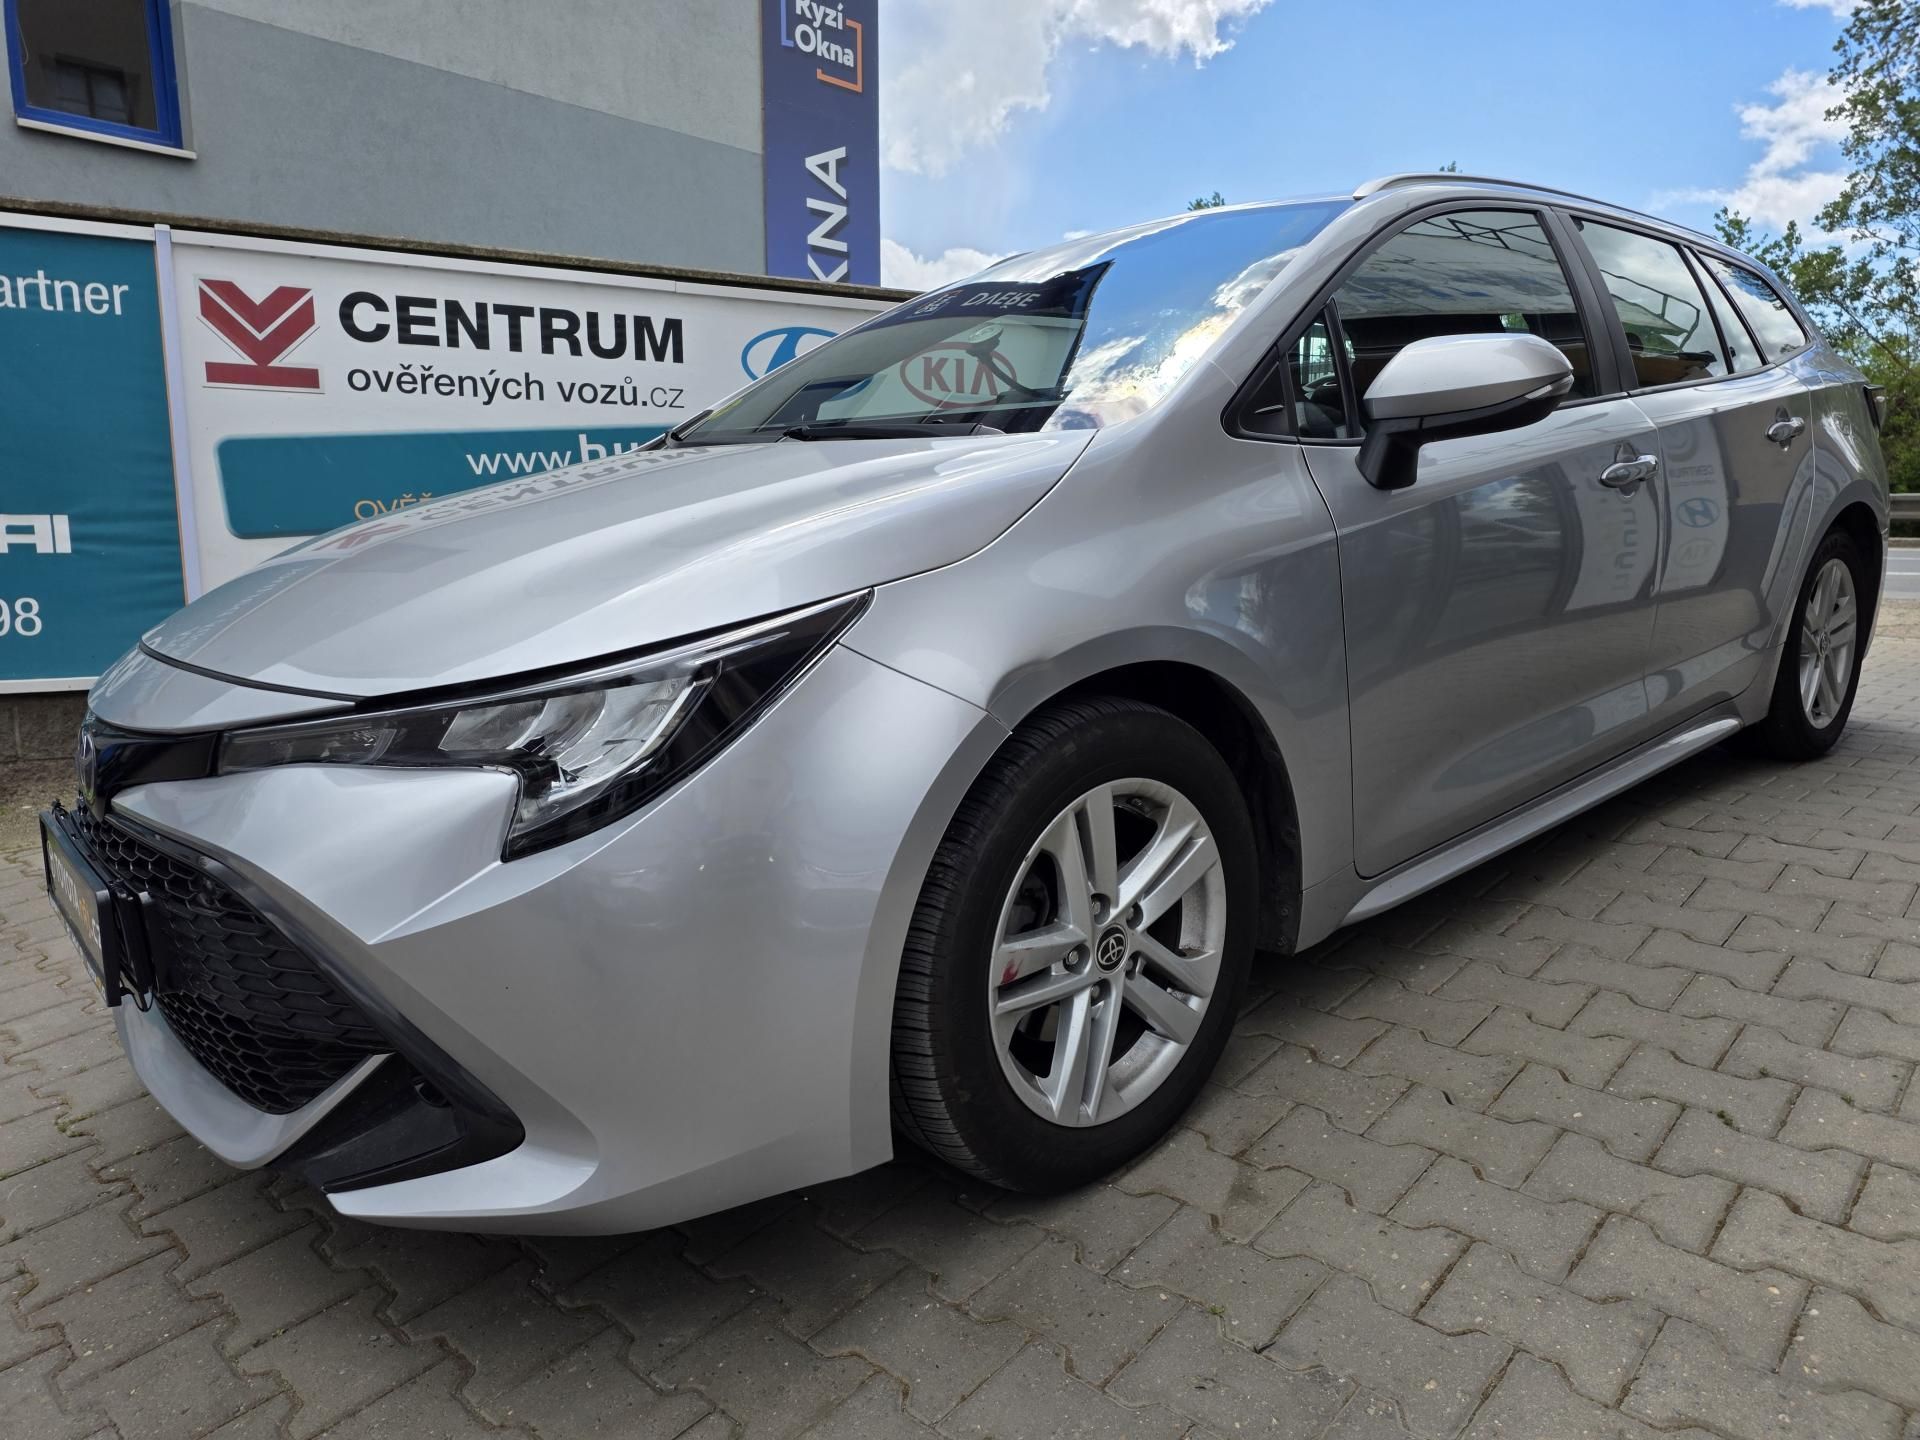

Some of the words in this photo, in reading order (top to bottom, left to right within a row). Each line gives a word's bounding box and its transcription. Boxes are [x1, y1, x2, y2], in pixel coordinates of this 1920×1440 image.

[794, 23, 854, 68] Okna
[0, 270, 129, 316] artner
[338, 291, 684, 364] CENTRUM
[347, 363, 545, 405] ověřených
[556, 376, 685, 409] vozů.cz
[921, 356, 999, 397] KIA
[466, 433, 638, 475] wwwh
